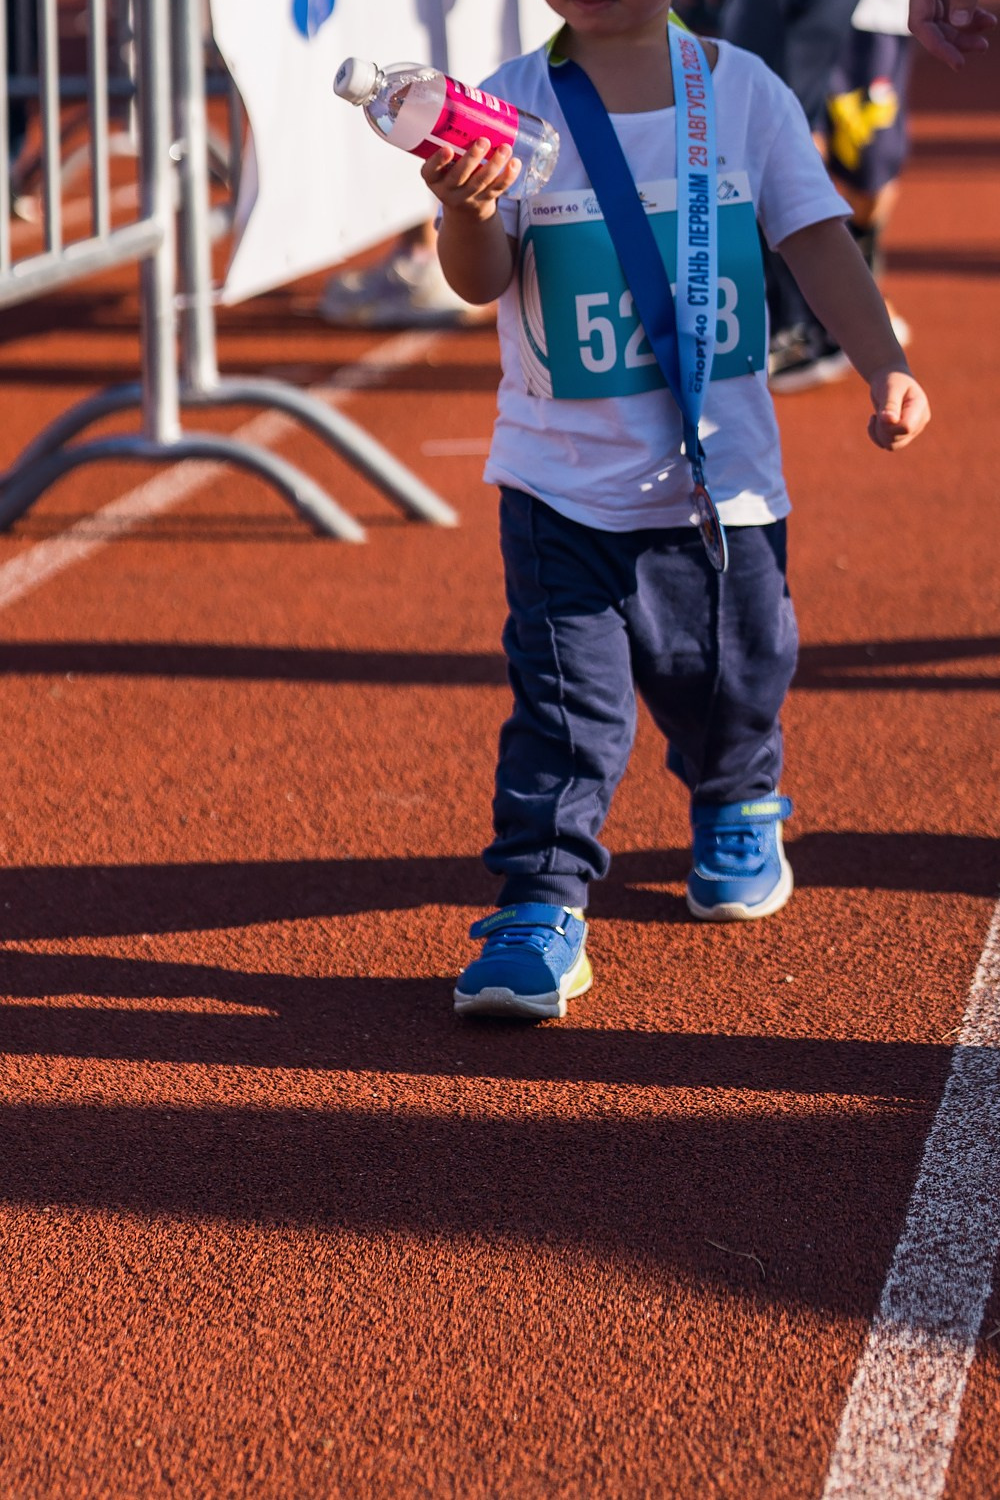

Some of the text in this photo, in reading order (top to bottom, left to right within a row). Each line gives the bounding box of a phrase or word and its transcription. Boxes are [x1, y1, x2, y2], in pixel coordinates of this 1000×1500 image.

[685, 73, 708, 142] АВГУСТА
[688, 145, 709, 167] 29
[532, 205, 564, 216] СПОРТ
[565, 203, 579, 213] 40
[688, 173, 709, 247] ПЕРВЫМ
[687, 251, 709, 306] СТАНЬ
[694, 314, 708, 394] СПОРТ 40
